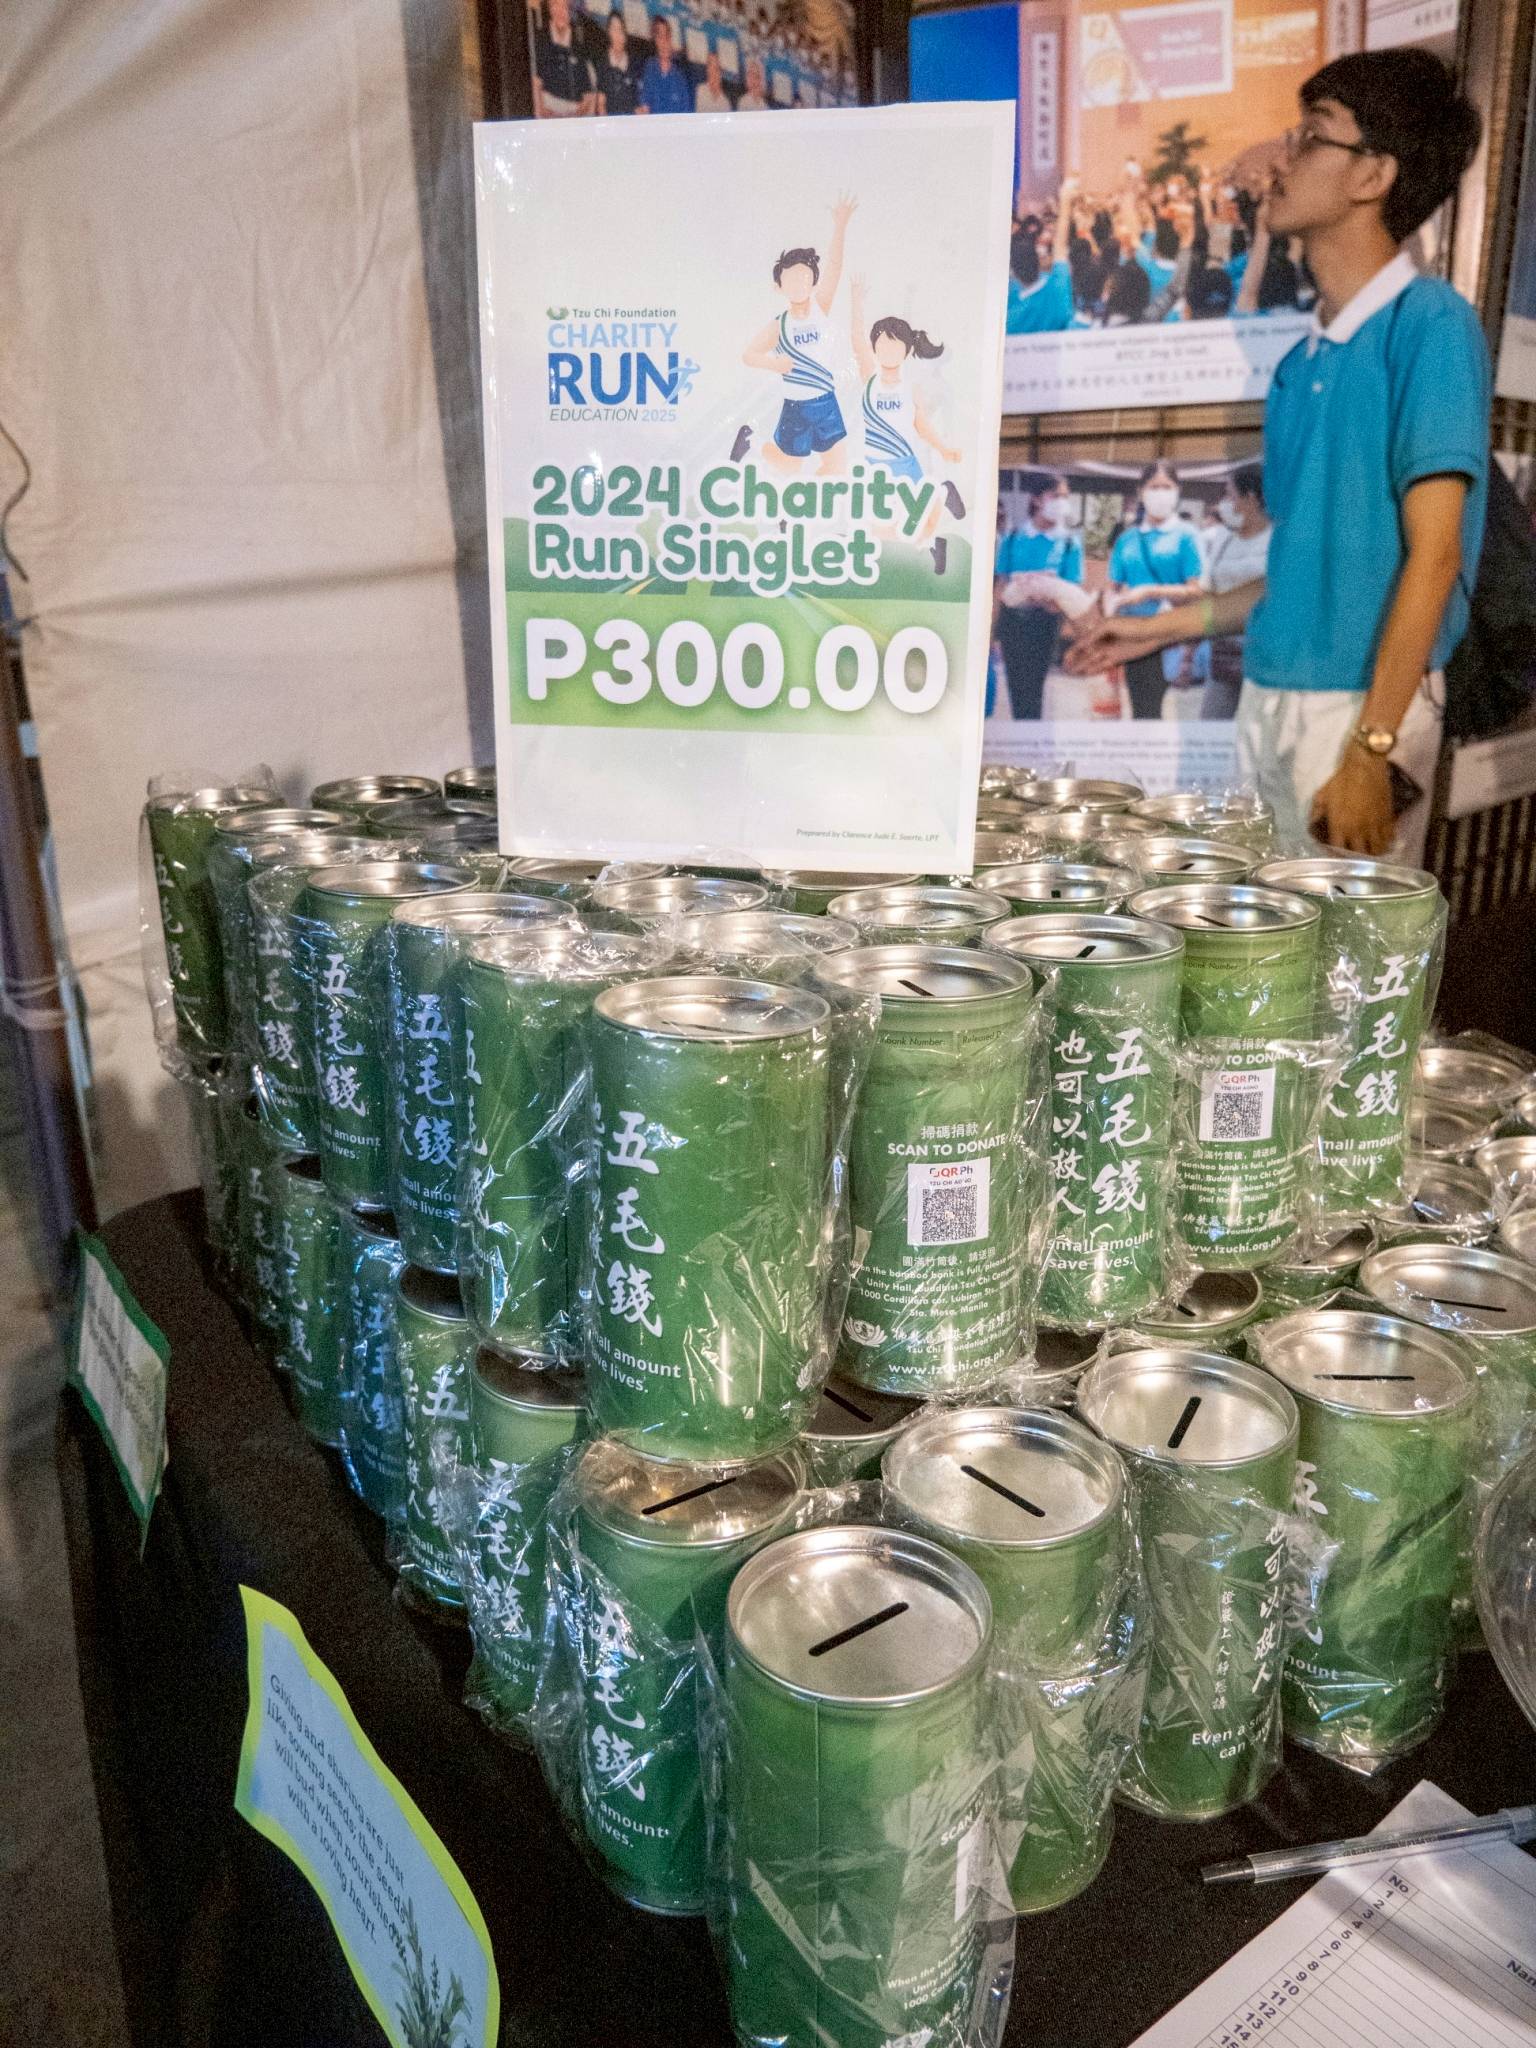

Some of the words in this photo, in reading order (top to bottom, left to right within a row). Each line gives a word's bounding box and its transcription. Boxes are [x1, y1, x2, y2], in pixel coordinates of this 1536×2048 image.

[573, 308, 590, 318] Tzu
[594, 308, 611, 318] Chi
[615, 308, 676, 318] Foundation
[547, 322, 678, 348] CHARITY
[794, 332, 818, 345] RUN
[548, 352, 679, 405] RUN
[876, 400, 900, 410] RUN
[550, 408, 638, 421] EDUCATION
[641, 409, 677, 422] 2025
[532, 464, 681, 518] 2024
[699, 464, 934, 536] Charity
[535, 523, 643, 576] Run
[662, 523, 876, 592] Singlet
[526, 618, 948, 714] P300.00
[321, 953, 367, 1117] 五毛錢
[1356, 954, 1410, 1117] 五毛錢
[1226, 1054, 1243, 1065] TO
[408, 994, 457, 1170] 五毛錢
[1231, 1075, 1247, 1083] QR
[1248, 1074, 1260, 1082] Ph
[1049, 1029, 1093, 1215] 也可以救人
[1091, 1027, 1151, 1215] 五毛錢
[334, 1129, 381, 1147] amount
[921, 1122, 979, 1140] 掃碼捐款
[888, 1143, 928, 1156] SCAN
[932, 1145, 953, 1156] TO
[957, 1133, 1006, 1154] DONATE
[940, 1167, 958, 1177] QR
[960, 1165, 973, 1175] Ph
[606, 1110, 665, 1338] 五毛錢
[1047, 1232, 1094, 1254] small
[1101, 1228, 1154, 1252] amount
[873, 1263, 887, 1276] the
[931, 1269, 954, 1280] bank
[956, 1270, 965, 1278] is
[1049, 1258, 1088, 1271] save
[866, 1278, 890, 1291] Unity
[961, 1281, 975, 1289] Tzu
[978, 1275, 990, 1285] Chi
[860, 1288, 881, 1300] 1000
[960, 1301, 988, 1314] Manila
[613, 1349, 682, 1379] amount
[610, 1362, 649, 1394] lives.
[1192, 1729, 1232, 1747] Even
[1219, 1739, 1246, 1760] can
[270, 1674, 303, 1733] Giving
[304, 1724, 325, 1759] and
[327, 1753, 364, 1824] sharing
[365, 1817, 383, 1851] are
[385, 1841, 405, 1890] just
[274, 1738, 294, 1773] will
[294, 1761, 316, 1802] bud
[316, 1796, 343, 1847] when
[267, 1697, 287, 1735] like
[288, 1730, 325, 1790] sowing
[358, 1830, 375, 1870] the
[376, 1866, 406, 1924] seeds
[600, 1800, 664, 1839] amount
[287, 1784, 310, 1825] with
[311, 1822, 318, 1836] a
[319, 1825, 348, 1893] loving
[1388, 1874, 1409, 1894] No
[1385, 1890, 1395, 1899] 1
[1373, 1899, 1385, 1910] 2
[1362, 1909, 1374, 1919] 3
[1351, 1919, 1364, 1930] 4
[1341, 1929, 1353, 1940] 5
[1330, 1940, 1341, 1950] 6
[1319, 1950, 1331, 1960] 7
[1307, 1961, 1319, 1971] 8
[1296, 1971, 1308, 1982] 9
[1282, 1979, 1300, 1996] 10
[904, 1993, 929, 2010] 1000
[1270, 1990, 1287, 2006] 11
[1258, 2001, 1277, 2019] 12
[1245, 2012, 1264, 2030] 13
[1233, 2024, 1251, 2041] 14
